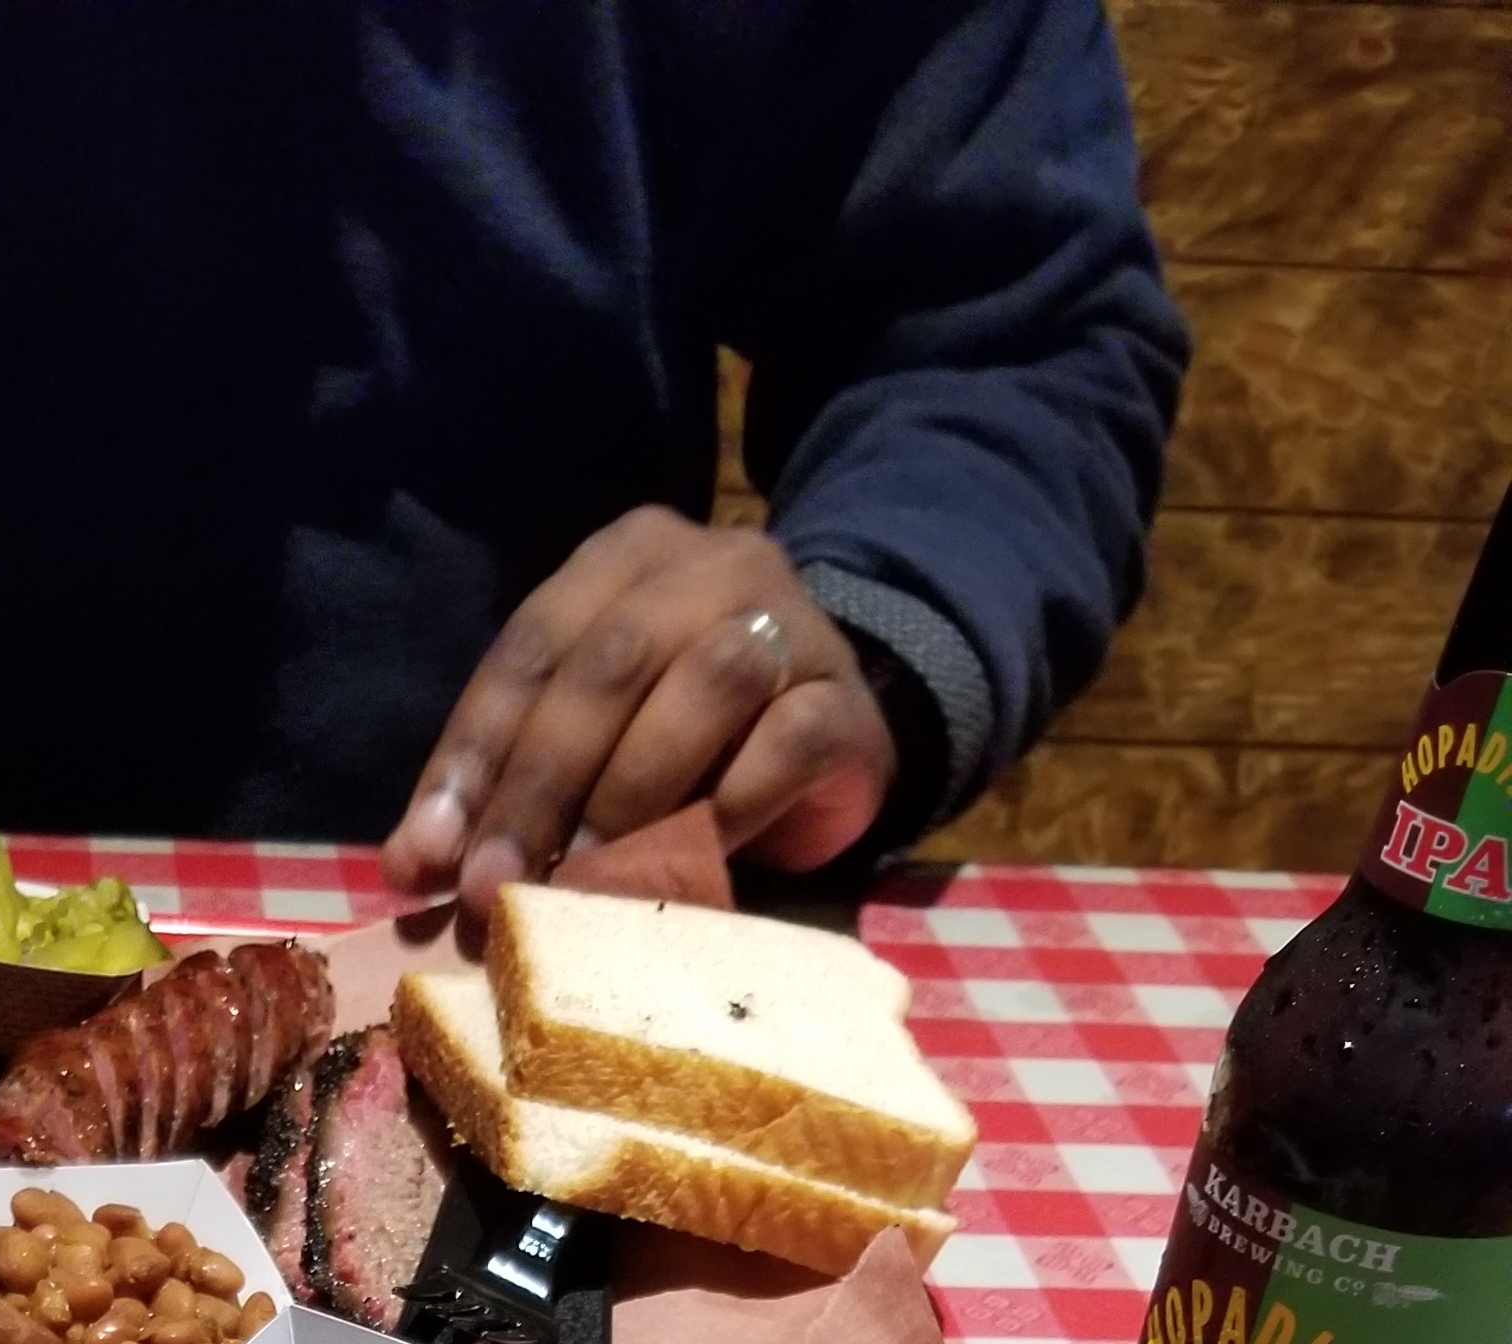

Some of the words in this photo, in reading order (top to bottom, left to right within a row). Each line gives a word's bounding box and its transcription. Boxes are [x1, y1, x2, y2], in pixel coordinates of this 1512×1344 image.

[1402, 723, 1512, 797] HOPADI
[1381, 800, 1512, 903] IPA
[1204, 1163, 1402, 1273] KARBACH
[1208, 1214, 1324, 1285] BREWING
